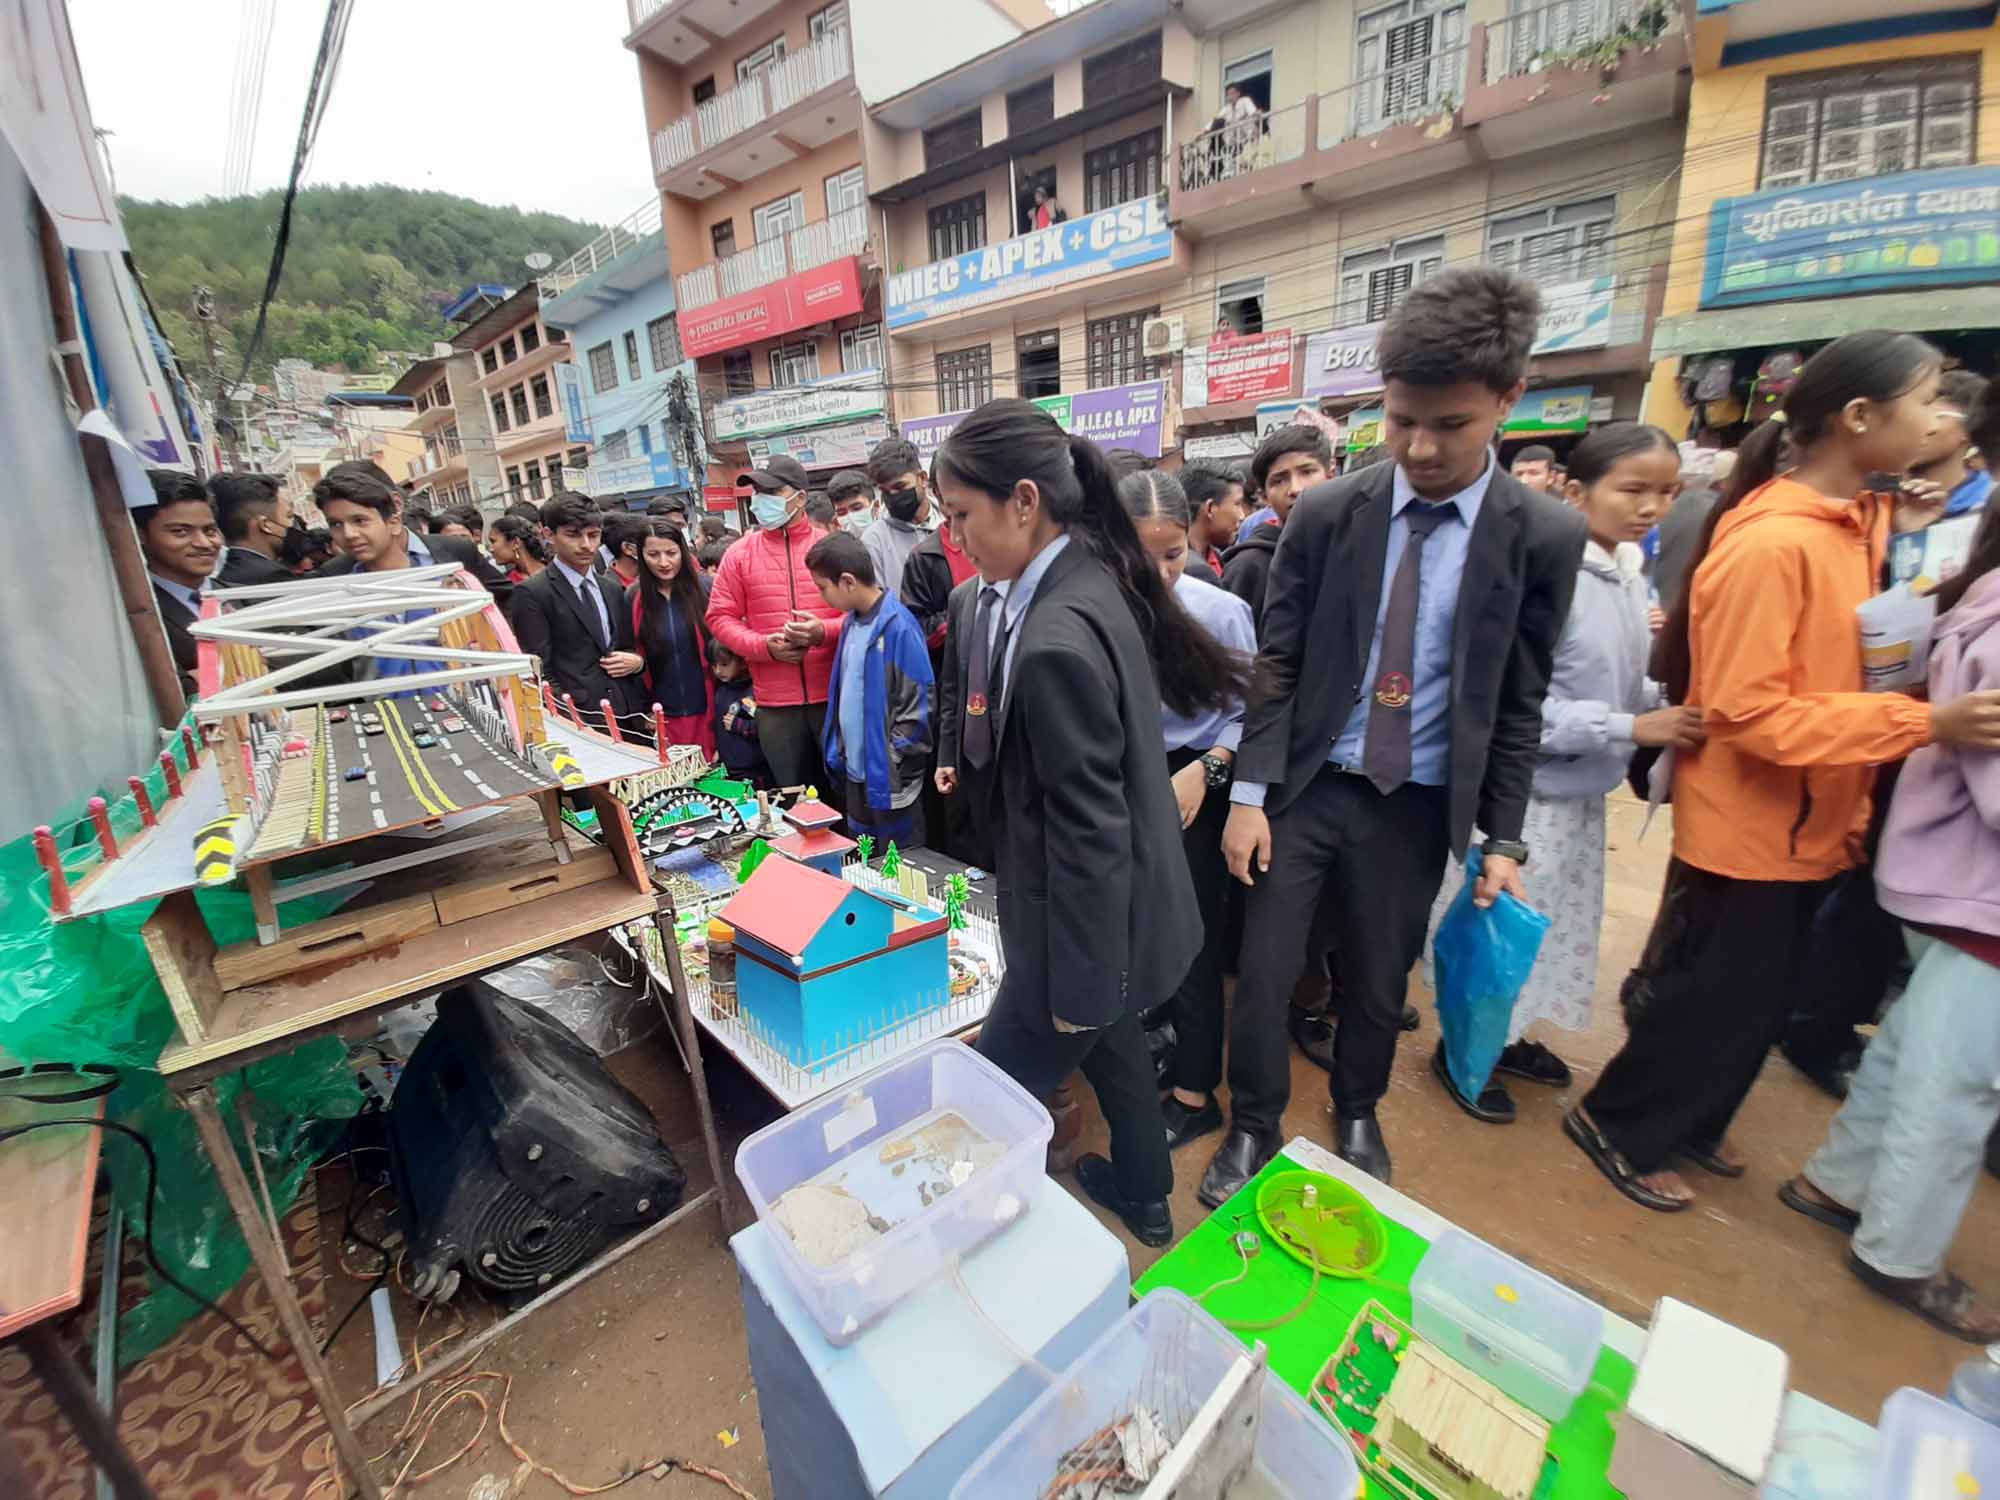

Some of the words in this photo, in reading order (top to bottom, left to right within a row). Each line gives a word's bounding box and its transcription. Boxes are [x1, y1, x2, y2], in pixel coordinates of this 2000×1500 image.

[889, 259, 960, 307] MIEC
[964, 261, 977, 281] +
[980, 226, 1065, 282] APEX
[1068, 230, 1085, 251] +
[1089, 195, 1169, 250] CSE
[819, 396, 850, 414] Limited
[1127, 405, 1157, 425] APEX
